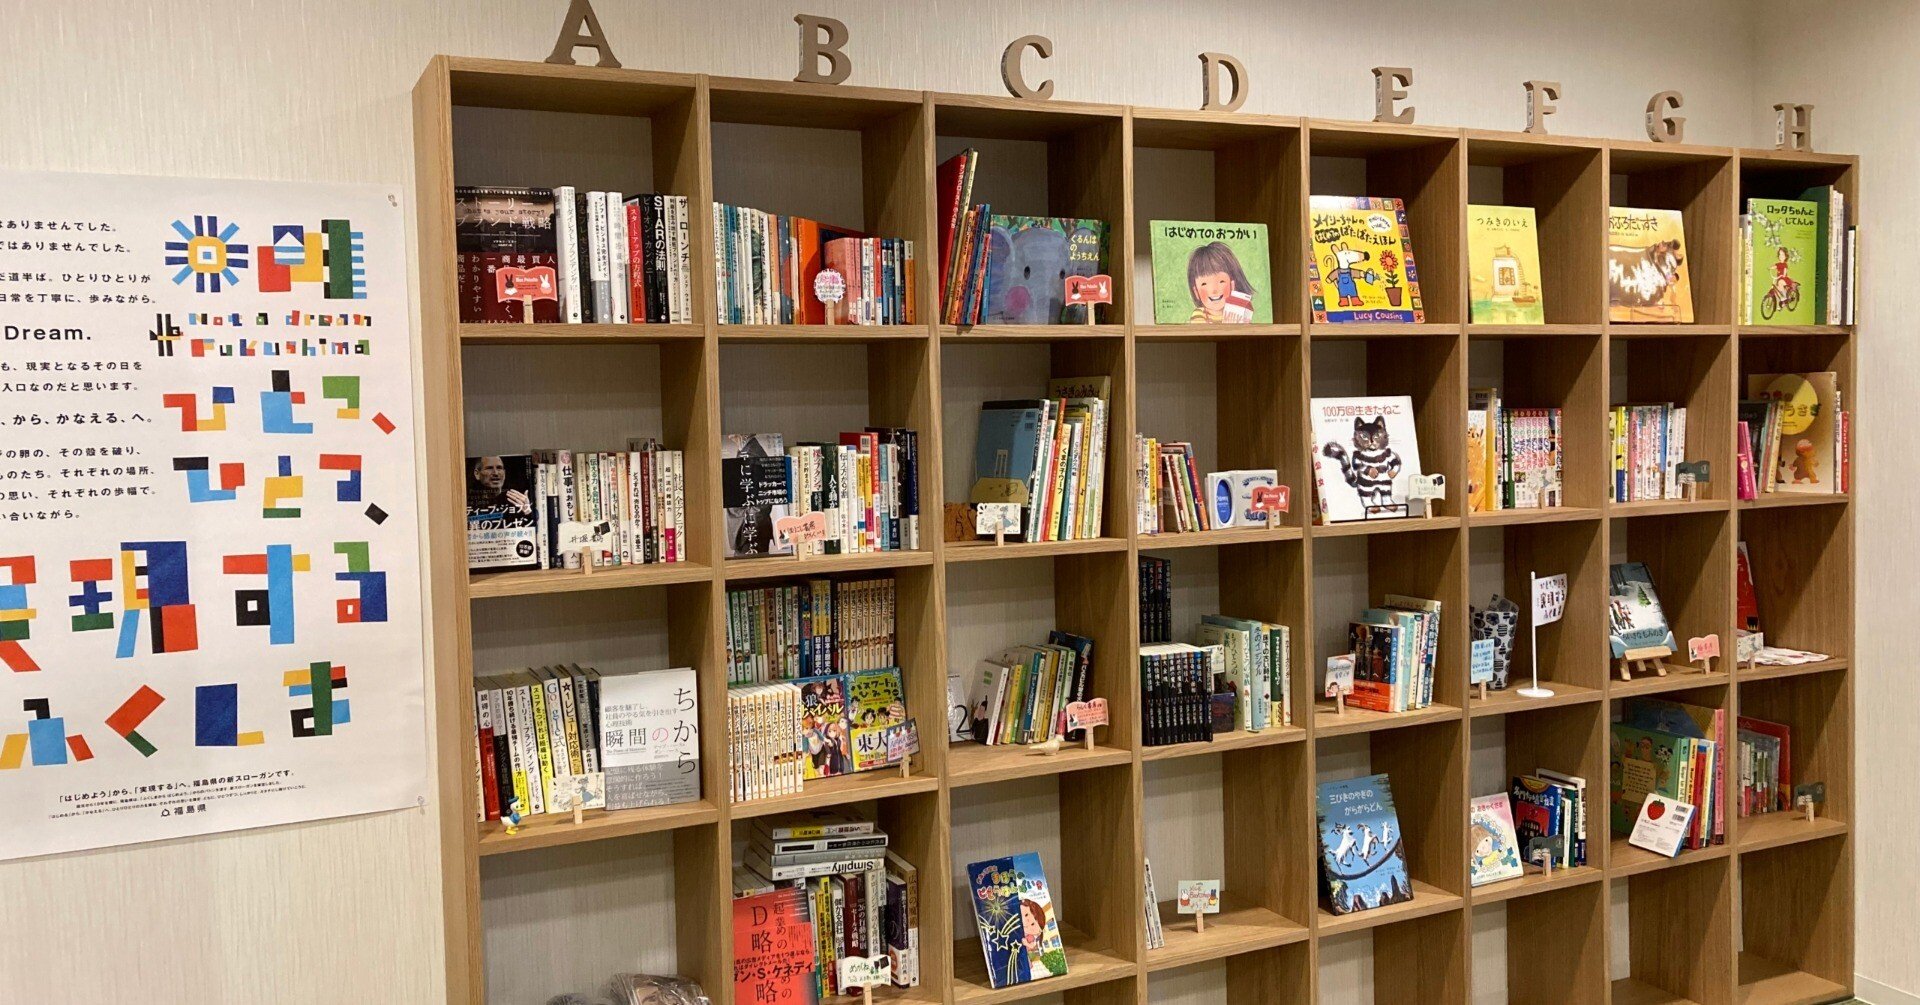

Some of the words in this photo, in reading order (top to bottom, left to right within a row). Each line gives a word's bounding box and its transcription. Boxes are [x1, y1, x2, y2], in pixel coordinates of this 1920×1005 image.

[545, 0, 622, 68] A
[793, 14, 852, 85] B
[1001, 35, 1053, 99] C
[1198, 52, 1249, 112] D
[1372, 66, 1416, 124] E
[1523, 80, 1562, 134] F
[1645, 90, 1685, 143] G
[1773, 103, 1814, 153] H
[465, 207, 491, 215] hat's
[1766, 205, 1815, 216] ロッタちゃんと
[1313, 213, 1365, 228] メイシーちゃんの
[1477, 217, 1529, 228] つみきのいえ
[1785, 217, 1814, 226] じてんしゃ
[654, 195, 666, 271] STARの法則
[679, 199, 690, 263] ザ・ローンチ
[1164, 226, 1257, 240] はじめてのおつかい
[1069, 252, 1100, 261] ようちえん
[1353, 312, 1372, 322] Lucy
[1375, 311, 1403, 320] Cousins
[4, 325, 92, 340] Dream.
[2, 382, 138, 392] 入口なのだと思います。
[1322, 405, 1401, 417] 100万回生きたねこ
[0, 446, 141, 459] の卵の、その殻を破り、
[562, 465, 574, 522] 仕事はおもし
[673, 688, 697, 775] ちから
[1329, 789, 1373, 804] 三びきのやぎの
[174, 803, 207, 817] 福島県
[1345, 802, 1383, 816] がらがらどん
[832, 861, 874, 873] Simplify
